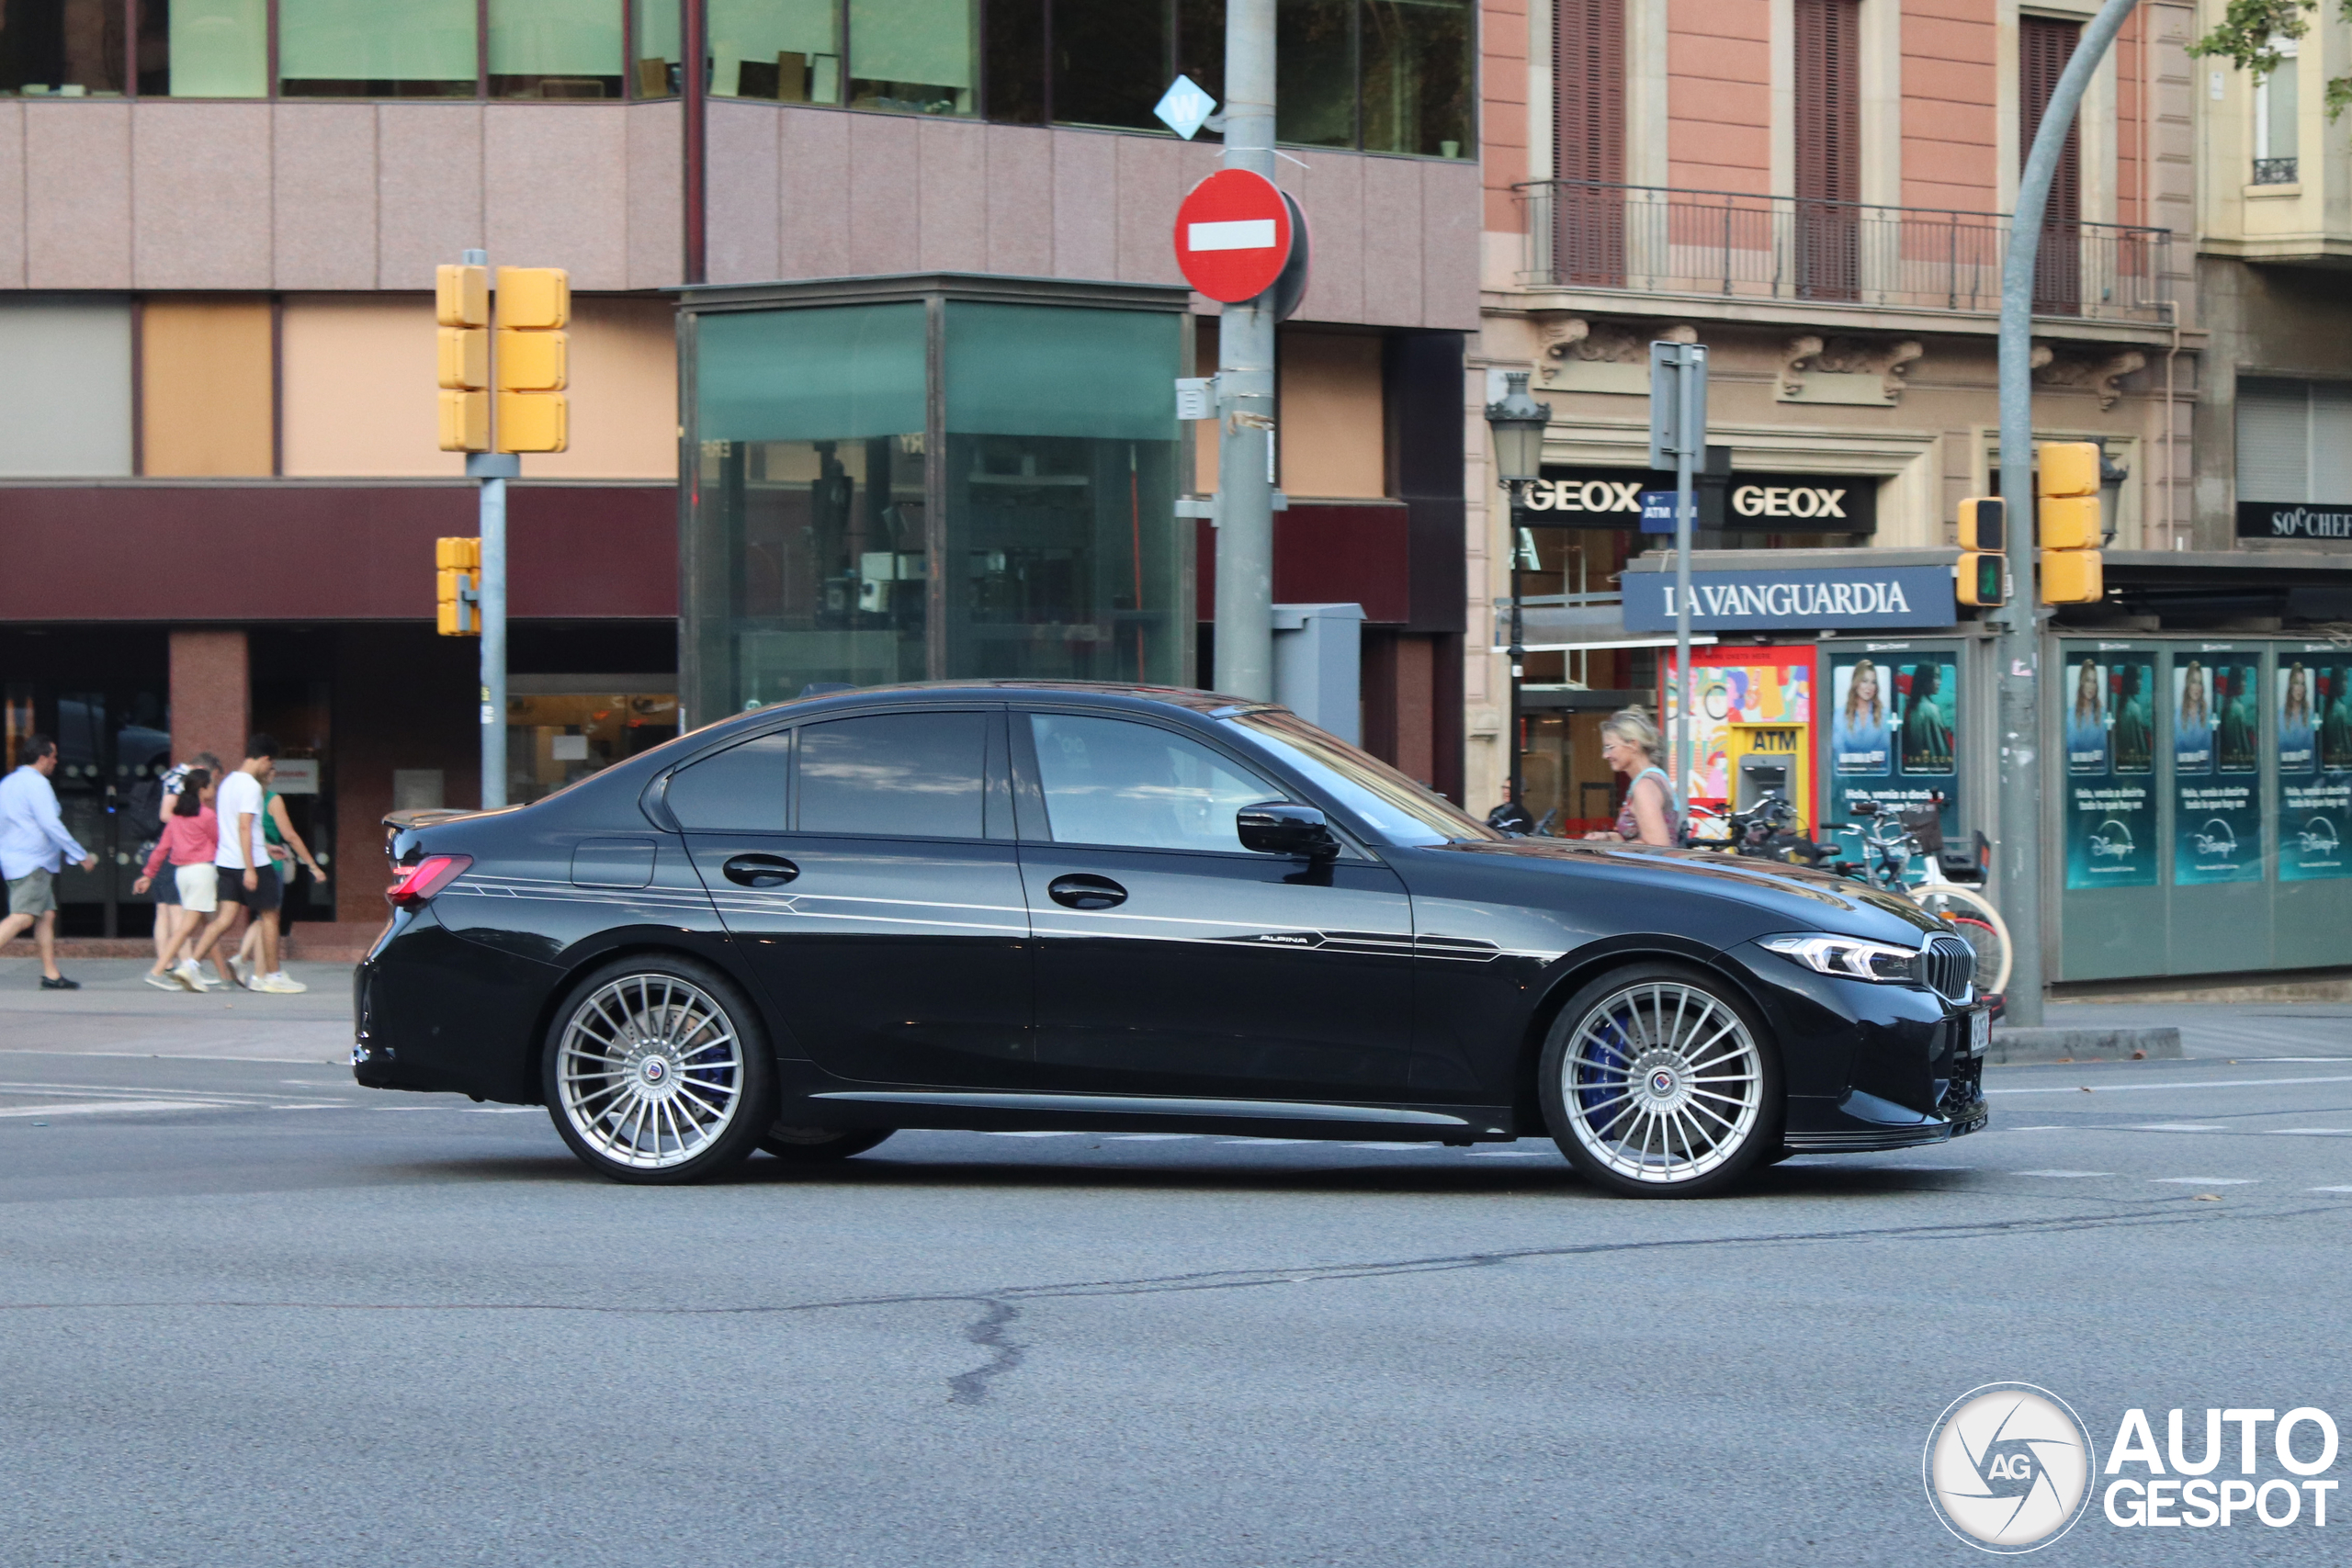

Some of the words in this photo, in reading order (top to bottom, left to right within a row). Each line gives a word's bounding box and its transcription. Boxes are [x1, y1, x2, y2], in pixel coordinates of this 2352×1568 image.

[1169, 93, 1201, 122] W
[1524, 480, 1644, 513] GEOX
[1733, 486, 1847, 518] GEOX
[1644, 506, 1671, 519] ATM
[1701, 581, 1911, 617] VANGUARDIA
[1753, 731, 1797, 750] ATM
[1260, 935, 1308, 943] ALPINA
